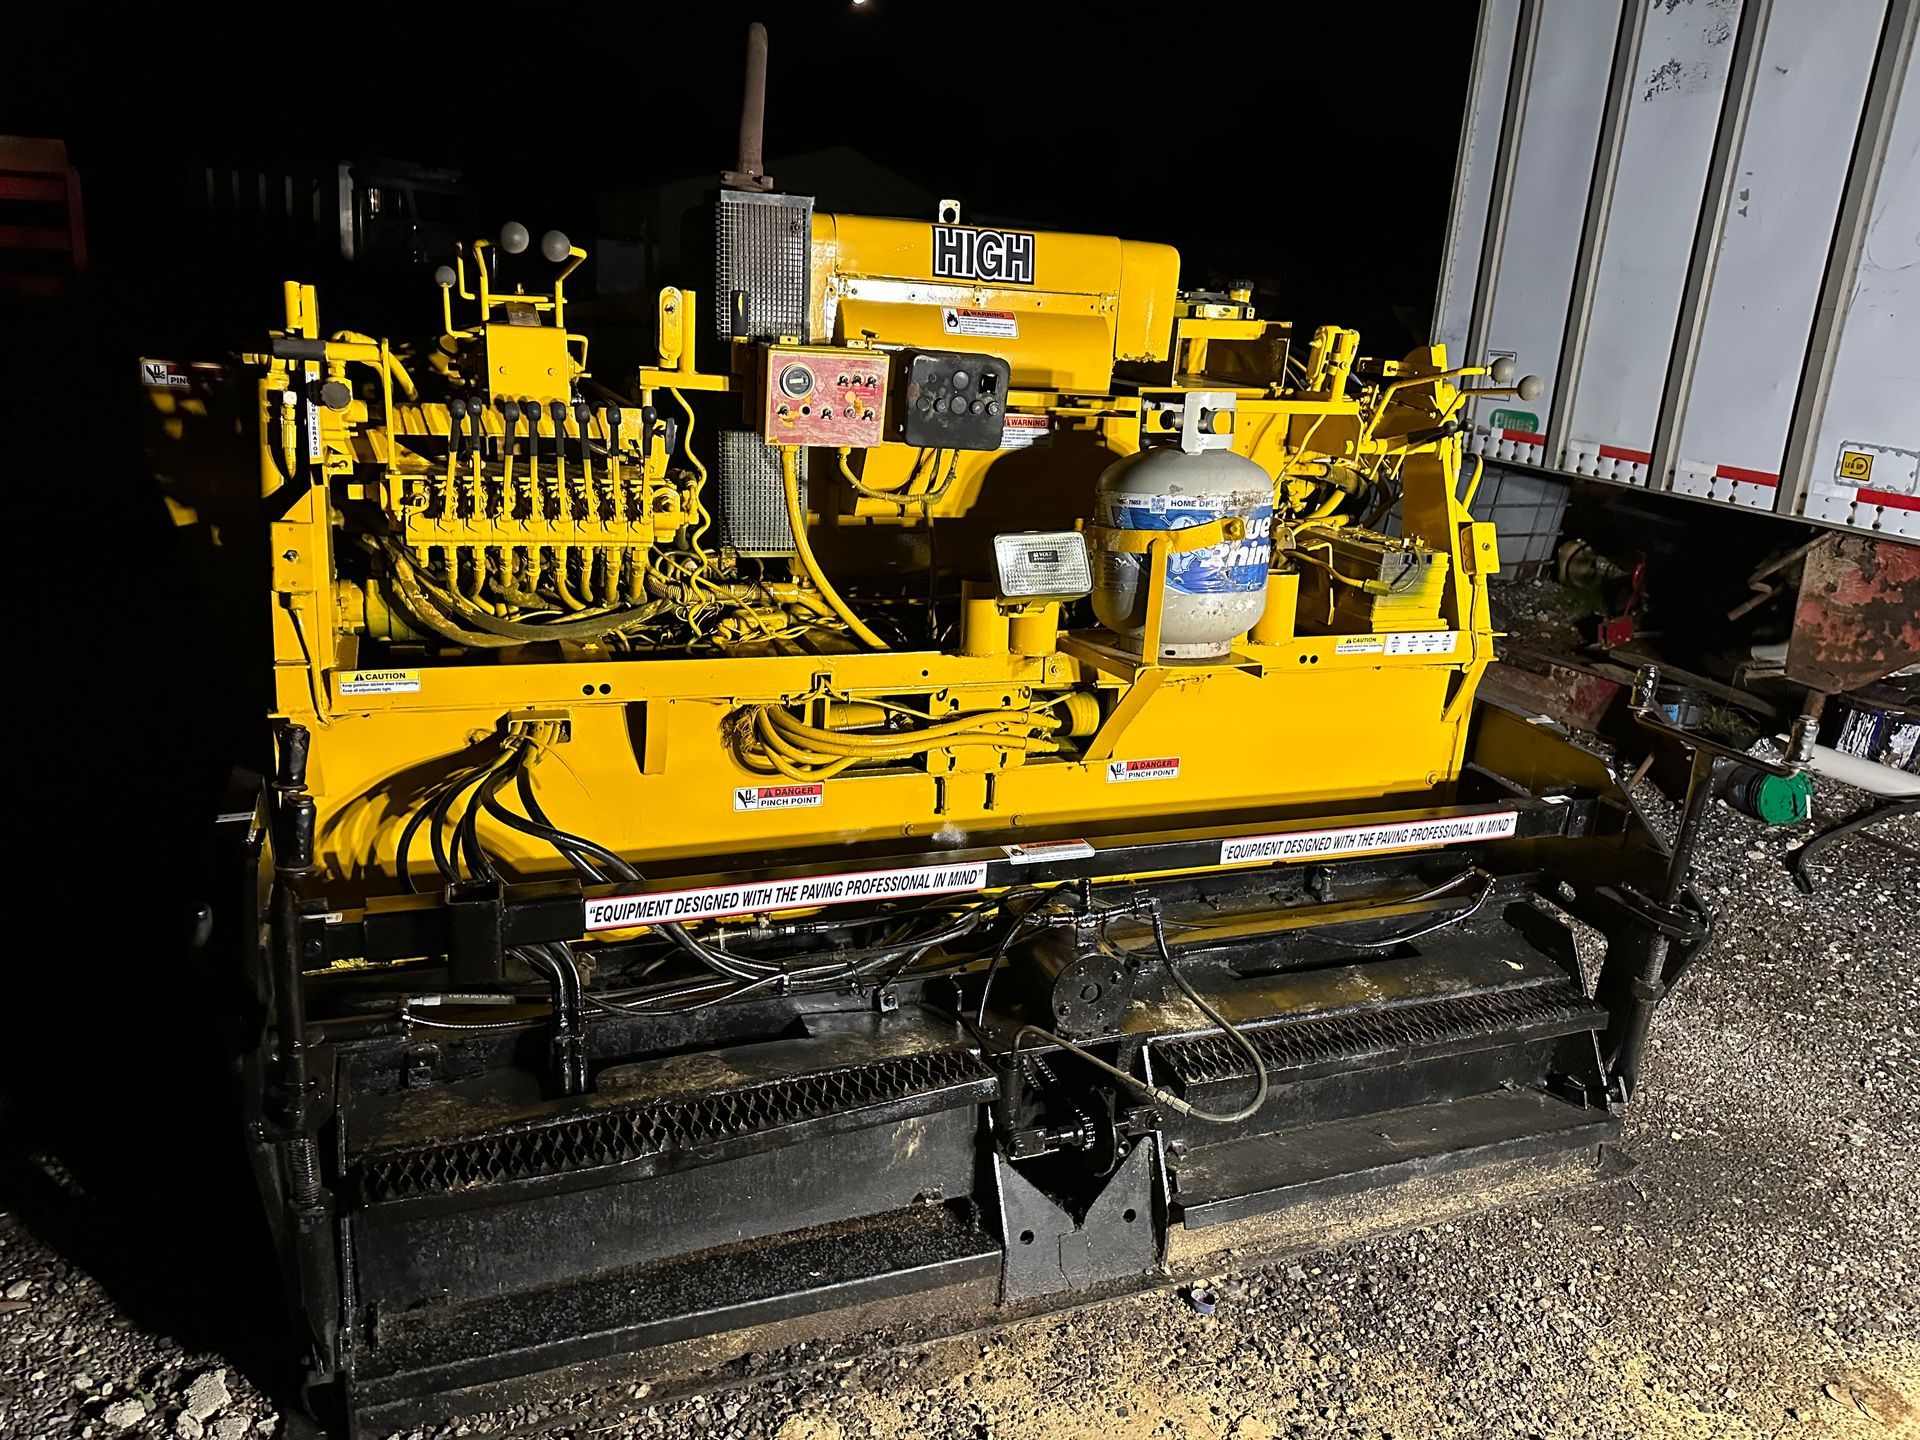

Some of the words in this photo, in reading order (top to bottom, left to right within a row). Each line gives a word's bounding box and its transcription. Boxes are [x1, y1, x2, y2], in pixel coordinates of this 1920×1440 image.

[935, 227, 1033, 282] HIGH
[971, 310, 1005, 318] WARNING
[1011, 419, 1046, 427] WARNING
[310, 416, 319, 456] VIBRATOR
[1170, 500, 1197, 508] HOME
[1200, 537, 1271, 568] Rhin
[365, 672, 406, 680] CAUTION
[1140, 760, 1173, 769] DANGER
[1128, 770, 1151, 778] PINCH
[775, 786, 814, 796] DANGER
[760, 798, 789, 807] PINCH
[790, 796, 818, 805] POINT
[1284, 836, 1332, 854] DESIGNED
[1333, 834, 1358, 850] WITH
[1357, 832, 1376, 848] THE
[1375, 829, 1409, 846] PAVING
[1409, 823, 1474, 842] PROFESSIONAL
[1475, 821, 1486, 835] IN
[674, 892, 740, 914] DESIGNED
[742, 888, 772, 907] WITH
[775, 885, 799, 903] THE
[799, 880, 843, 901] PAVING
[845, 873, 931, 896] PROFESSIONAL
[933, 872, 948, 888] IN
